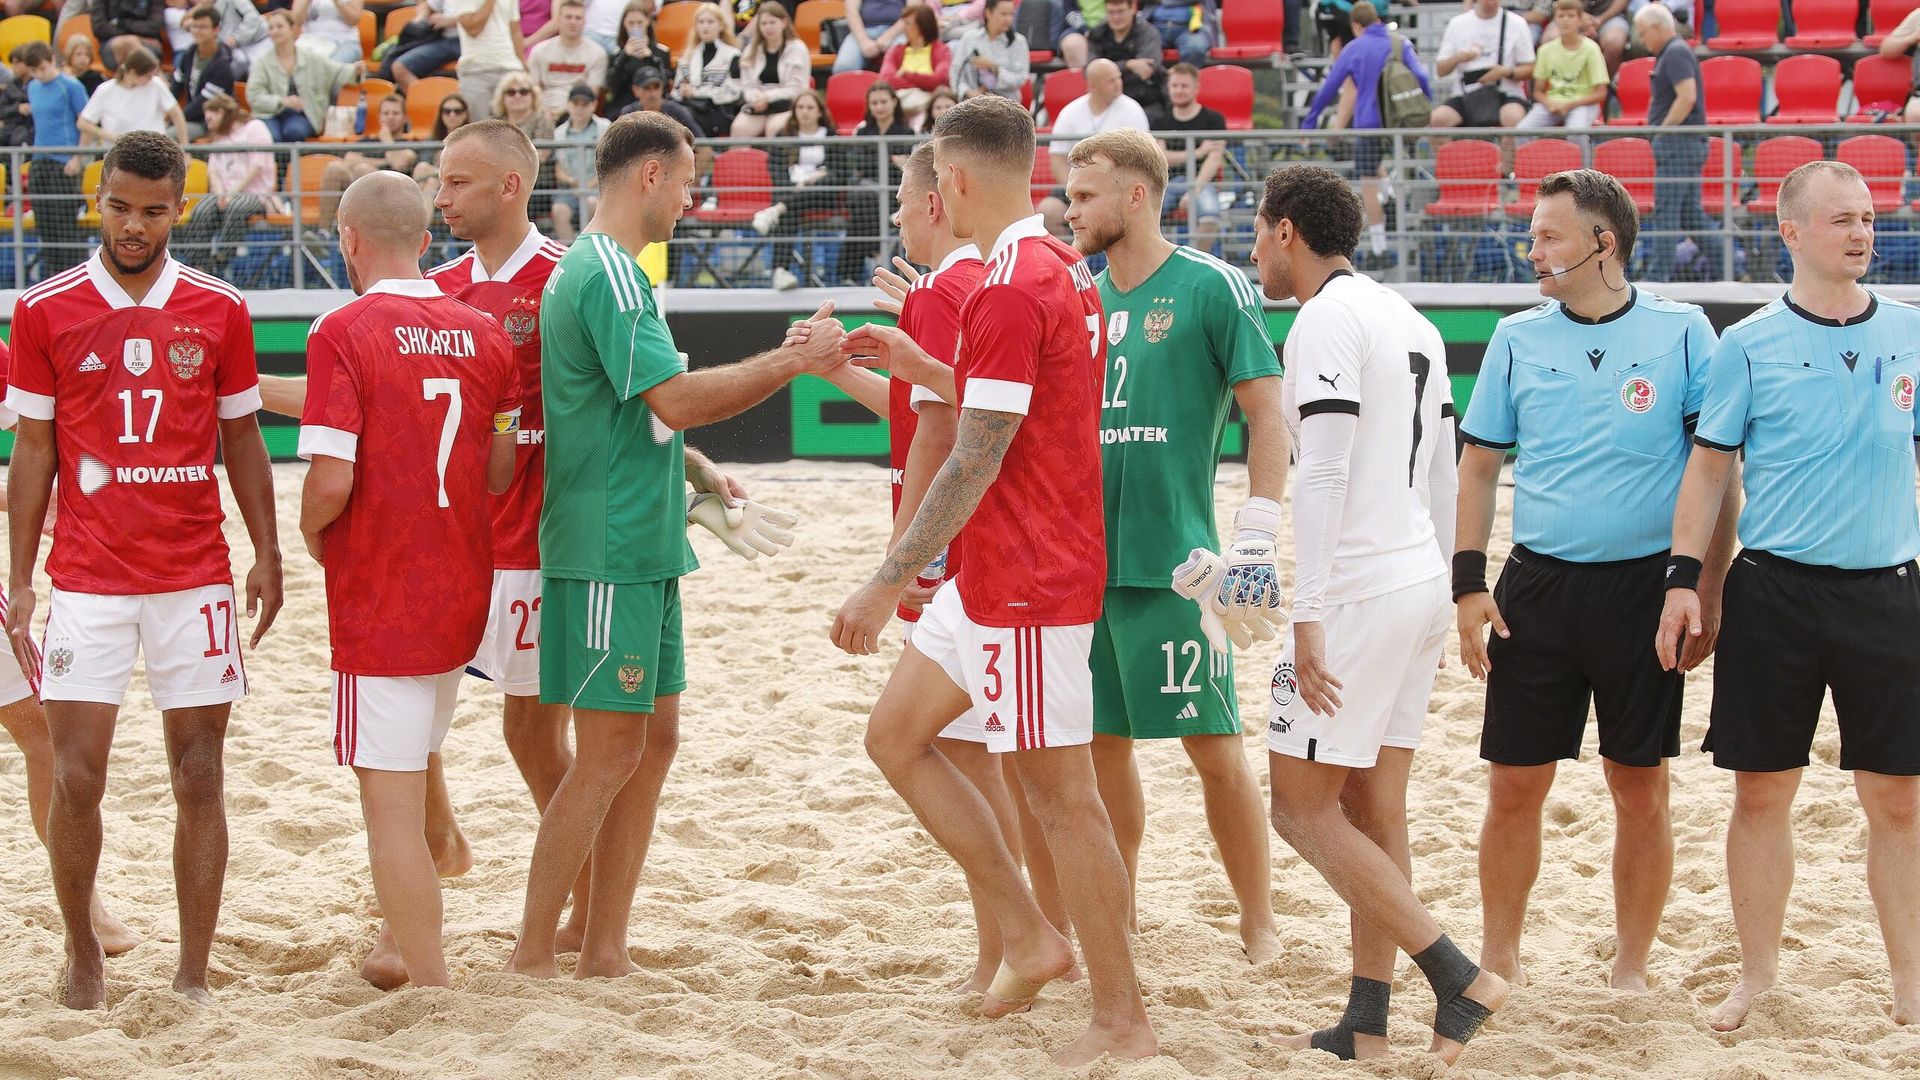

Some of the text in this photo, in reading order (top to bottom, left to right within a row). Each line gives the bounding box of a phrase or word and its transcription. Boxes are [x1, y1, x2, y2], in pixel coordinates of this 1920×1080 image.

[79, 363, 106, 372] adidas
[394, 326, 476, 358] SHKARIN
[117, 389, 164, 444] 17
[423, 378, 462, 507] 7
[116, 465, 209, 484] NOVATEK
[200, 600, 231, 658] 17
[982, 643, 1003, 702] 3
[1160, 640, 1202, 694] 12
[1269, 721, 1287, 734] PUMA
